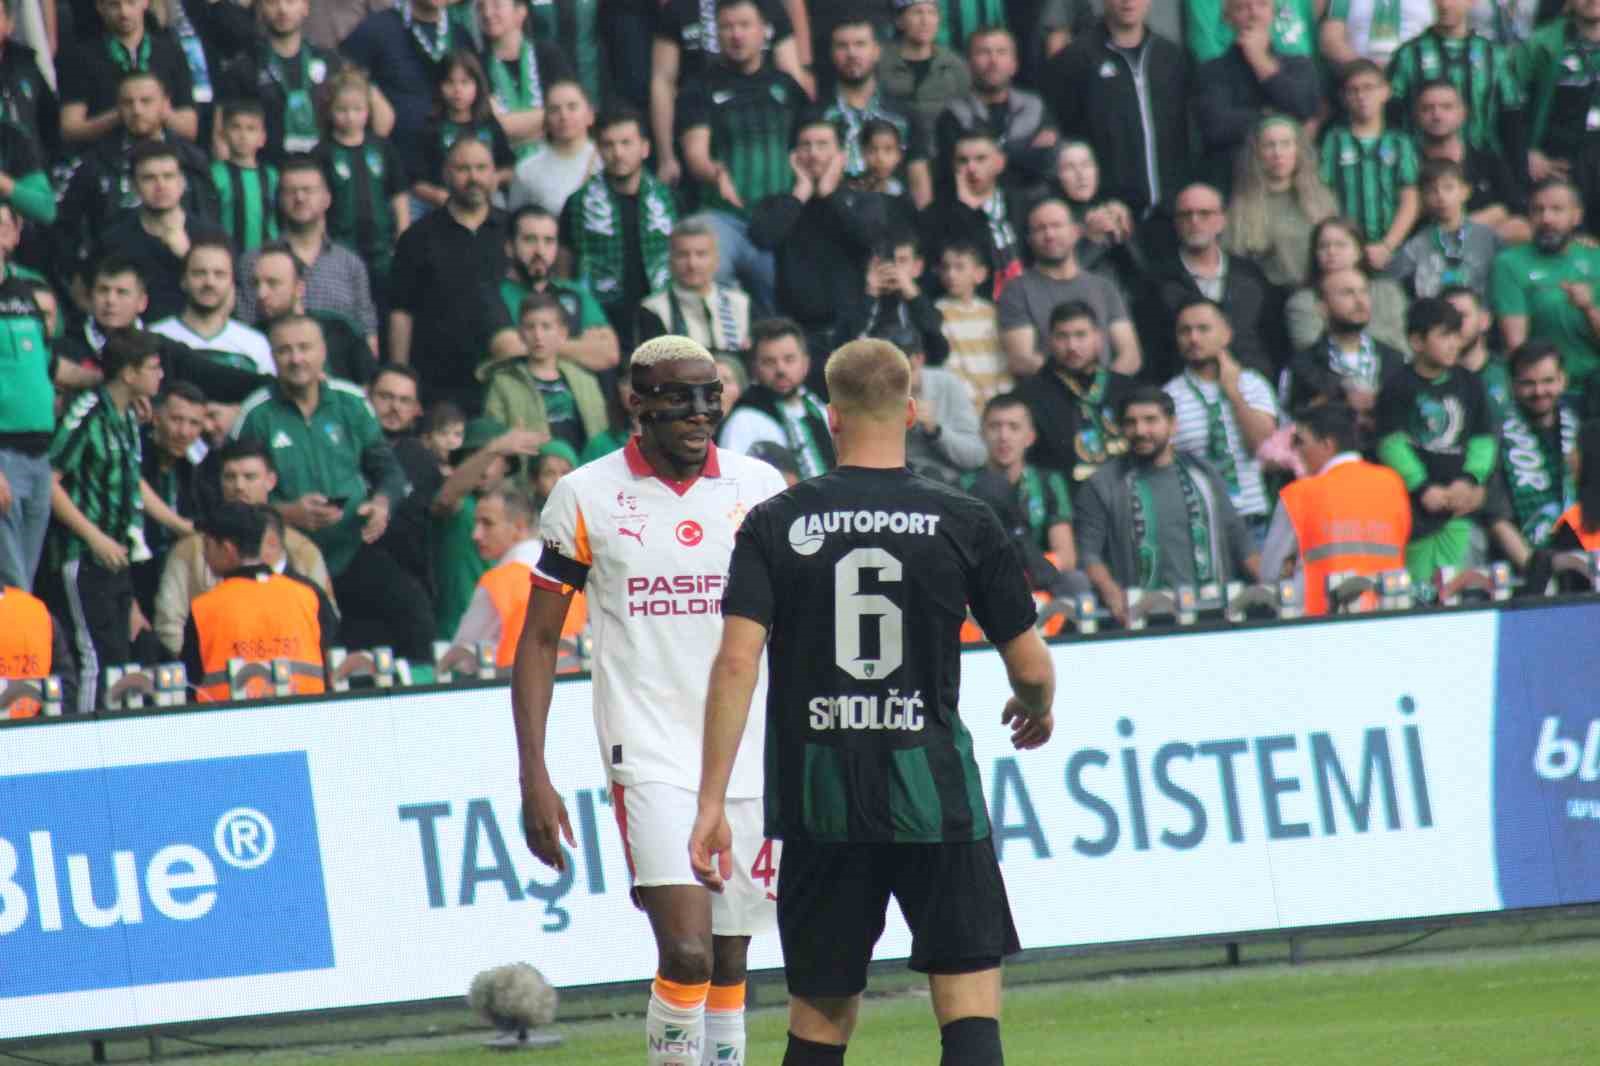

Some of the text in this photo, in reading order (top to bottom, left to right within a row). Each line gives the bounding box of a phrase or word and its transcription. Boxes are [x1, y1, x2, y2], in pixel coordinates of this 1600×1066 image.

[806, 510, 941, 536] AUTOPORT
[834, 547, 903, 680] 6
[808, 688, 925, 732] SMOLČIĆ
[397, 786, 613, 934] TAŞI
[1063, 694, 1434, 858] SİSTEMİ
[751, 838, 776, 888] 4
